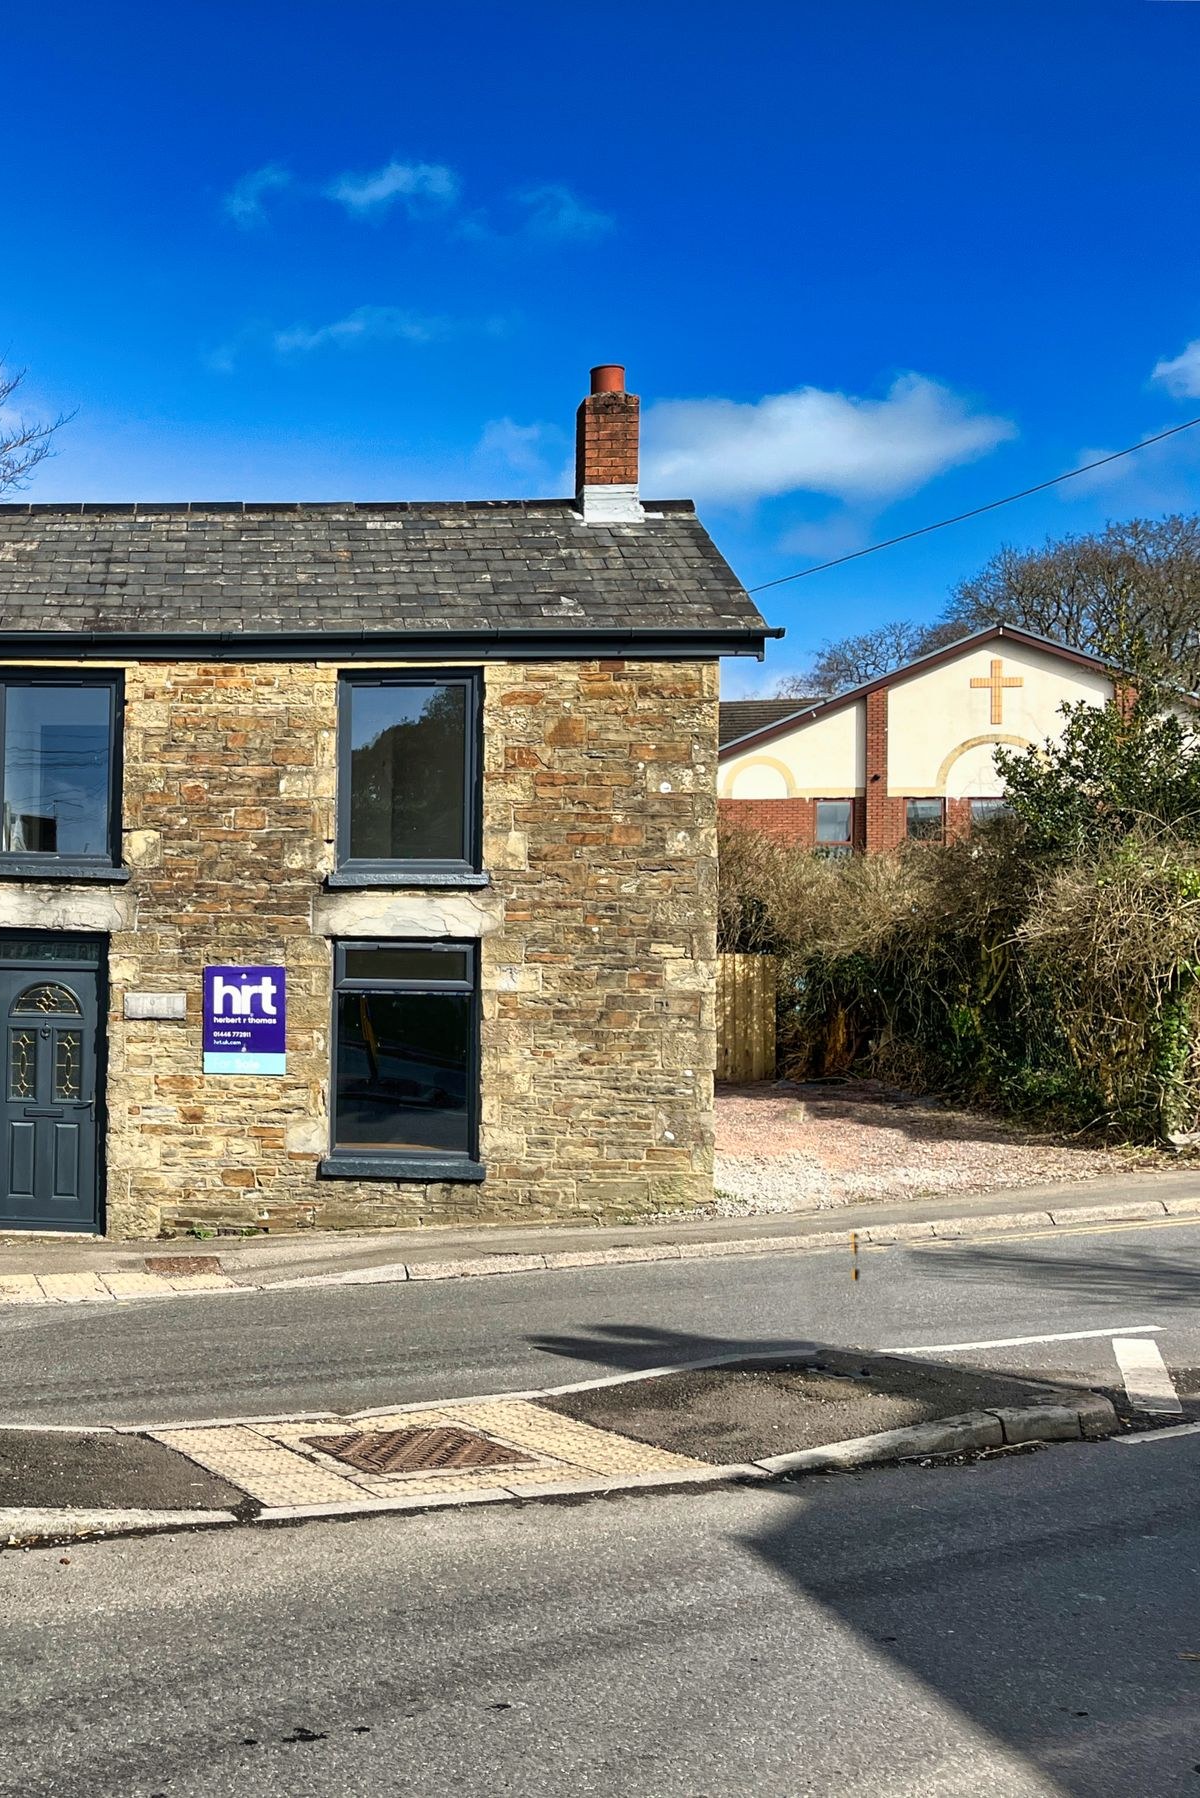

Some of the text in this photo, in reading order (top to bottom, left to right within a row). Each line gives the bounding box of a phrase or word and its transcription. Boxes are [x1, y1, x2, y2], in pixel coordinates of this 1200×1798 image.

[213, 976, 277, 1015] hrt
[213, 1016, 241, 1024] herbert
[248, 1016, 276, 1024] thomas
